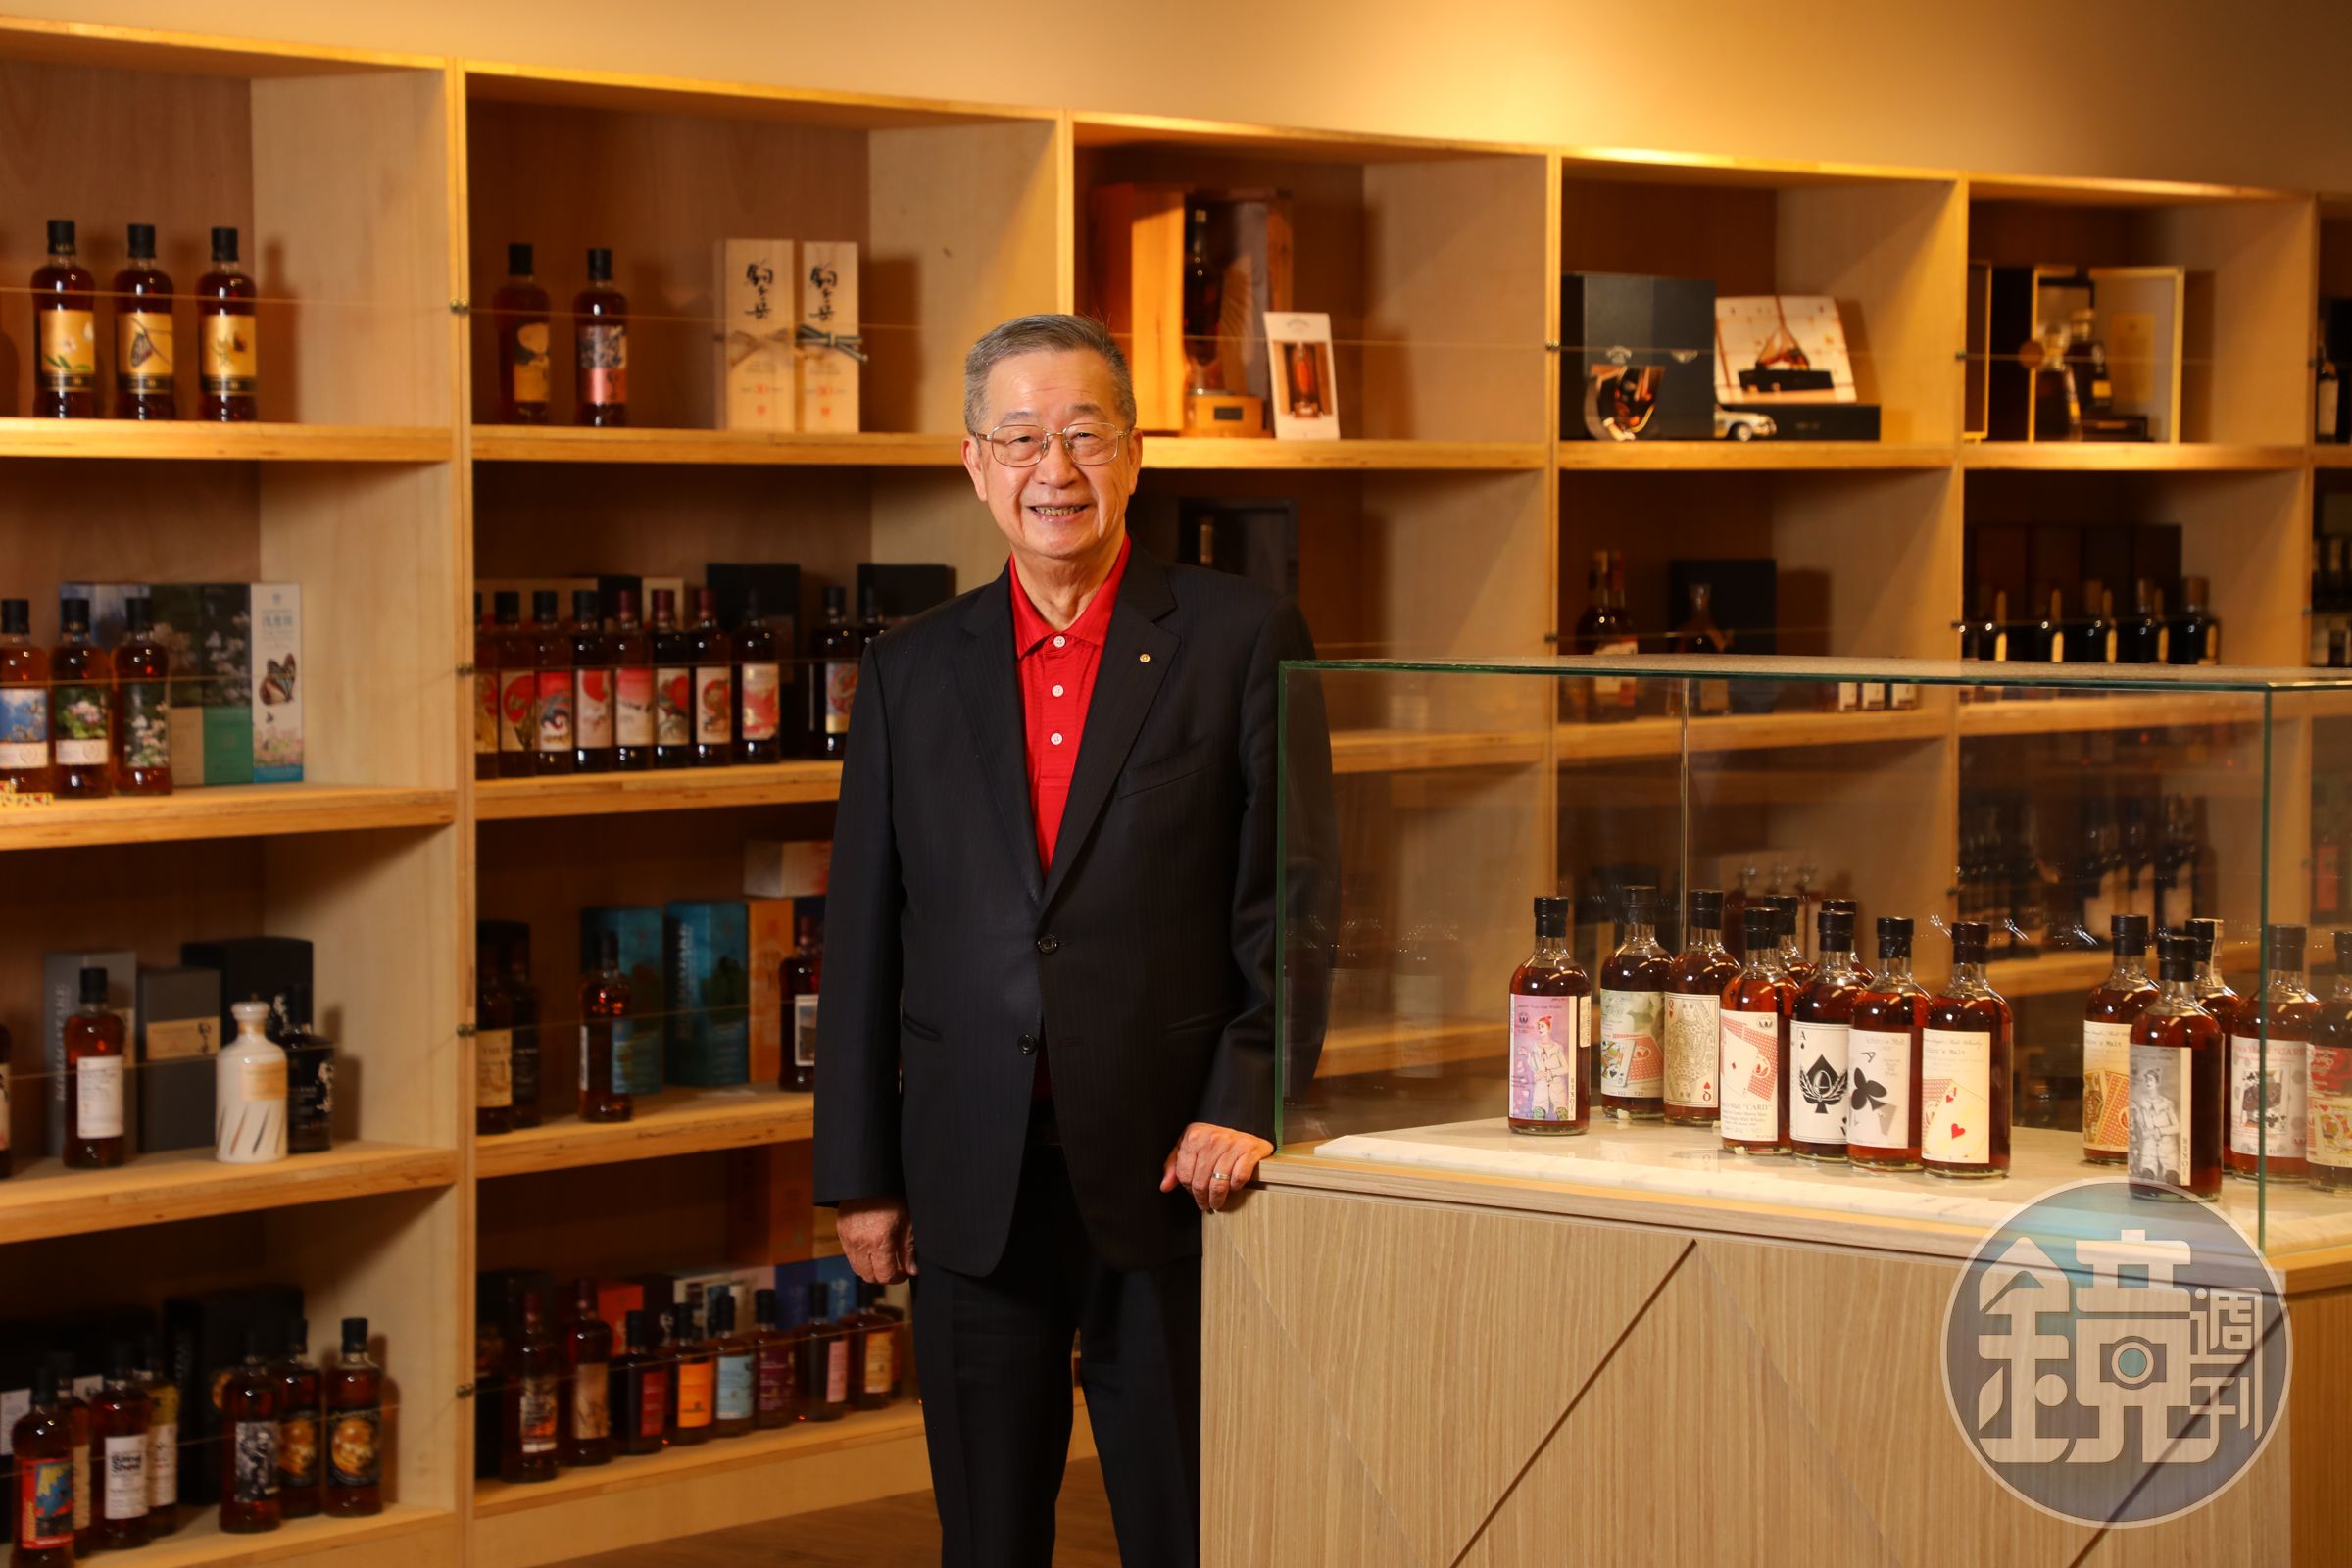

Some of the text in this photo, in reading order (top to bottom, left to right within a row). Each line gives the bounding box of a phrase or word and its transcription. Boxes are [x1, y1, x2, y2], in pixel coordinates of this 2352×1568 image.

[1668, 999, 1674, 1009] Q
[1800, 1030, 1806, 1040] A
[1860, 1051, 1877, 1063] A
[1702, 1090, 1712, 1102] Q
